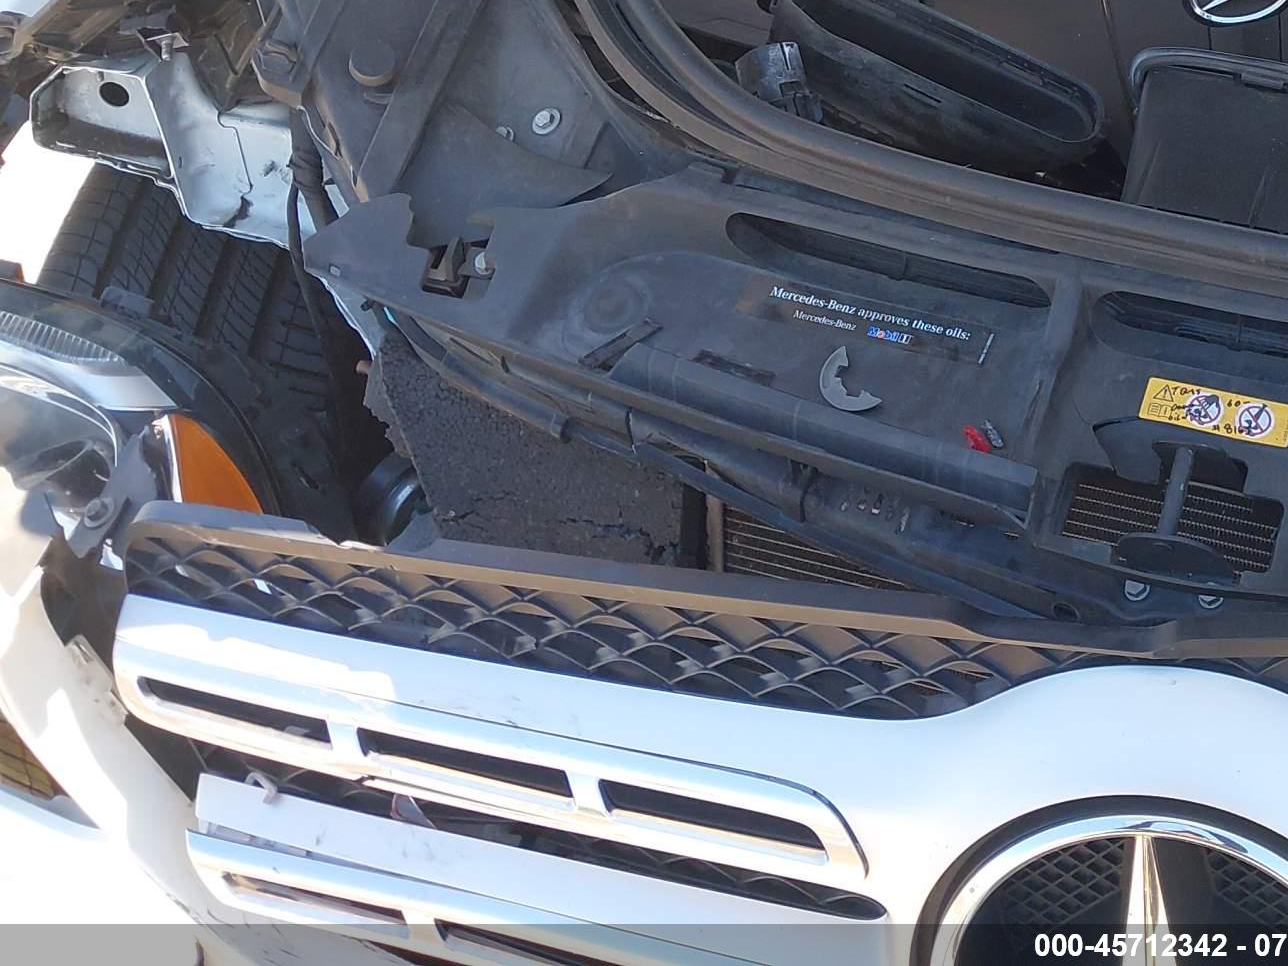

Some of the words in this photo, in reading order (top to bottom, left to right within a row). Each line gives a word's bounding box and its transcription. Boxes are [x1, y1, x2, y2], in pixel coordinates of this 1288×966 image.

[769, 285, 857, 315] Mercedes-Benz
[857, 307, 915, 327] approves
[911, 319, 944, 335] these
[945, 326, 972, 341] oils:
[793, 309, 857, 332] Mercedes-Benz
[866, 326, 900, 342] Mobil
